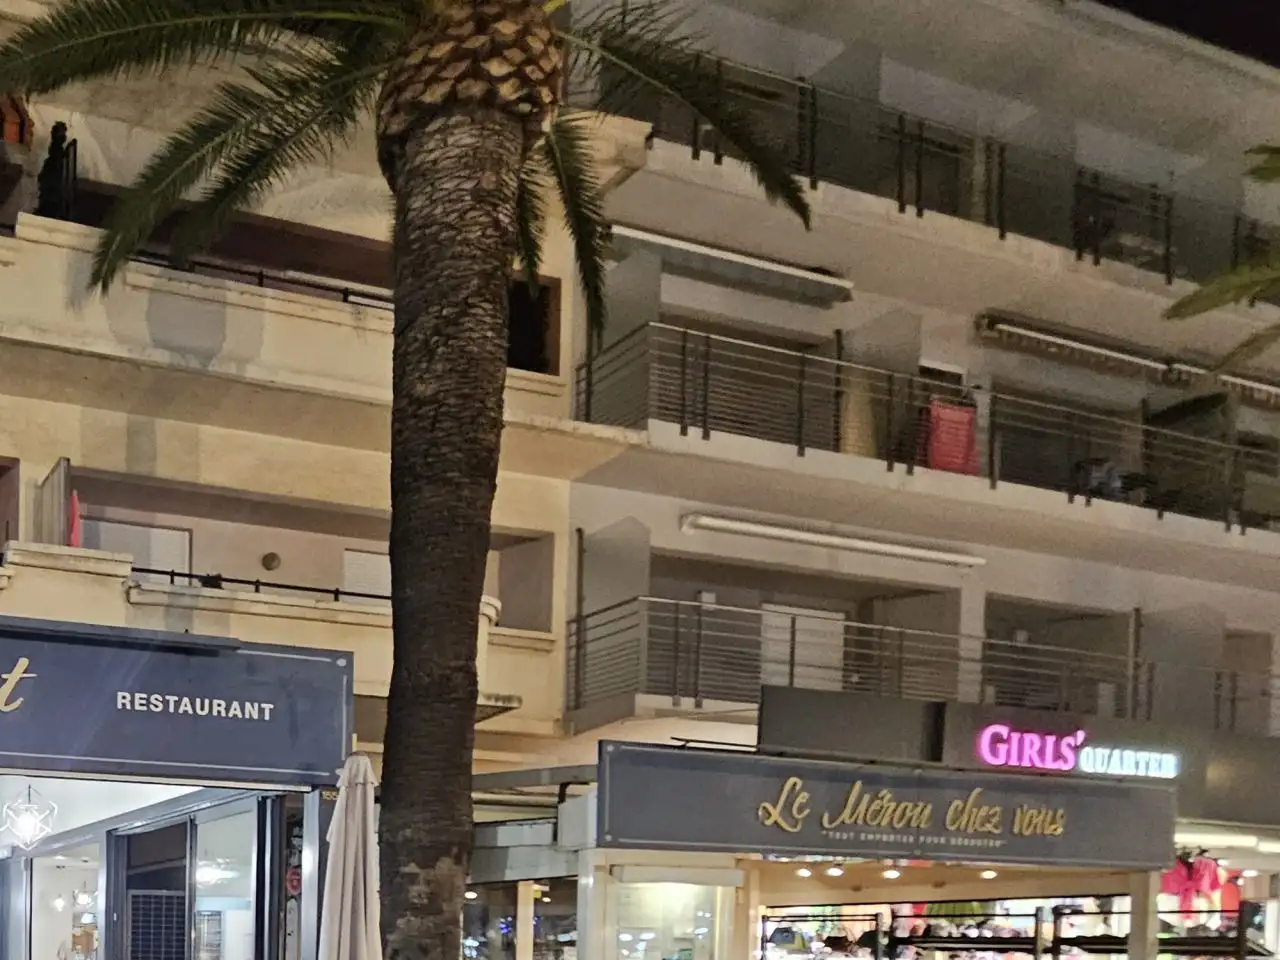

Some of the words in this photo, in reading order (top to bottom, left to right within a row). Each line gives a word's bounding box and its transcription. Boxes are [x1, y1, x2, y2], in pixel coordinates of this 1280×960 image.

[116, 692, 274, 721] RESTAURANT
[1079, 746, 1180, 779] QUARTER
[758, 777, 811, 832] Le
[822, 780, 933, 829] Mérou
[1013, 804, 1066, 836] vous
